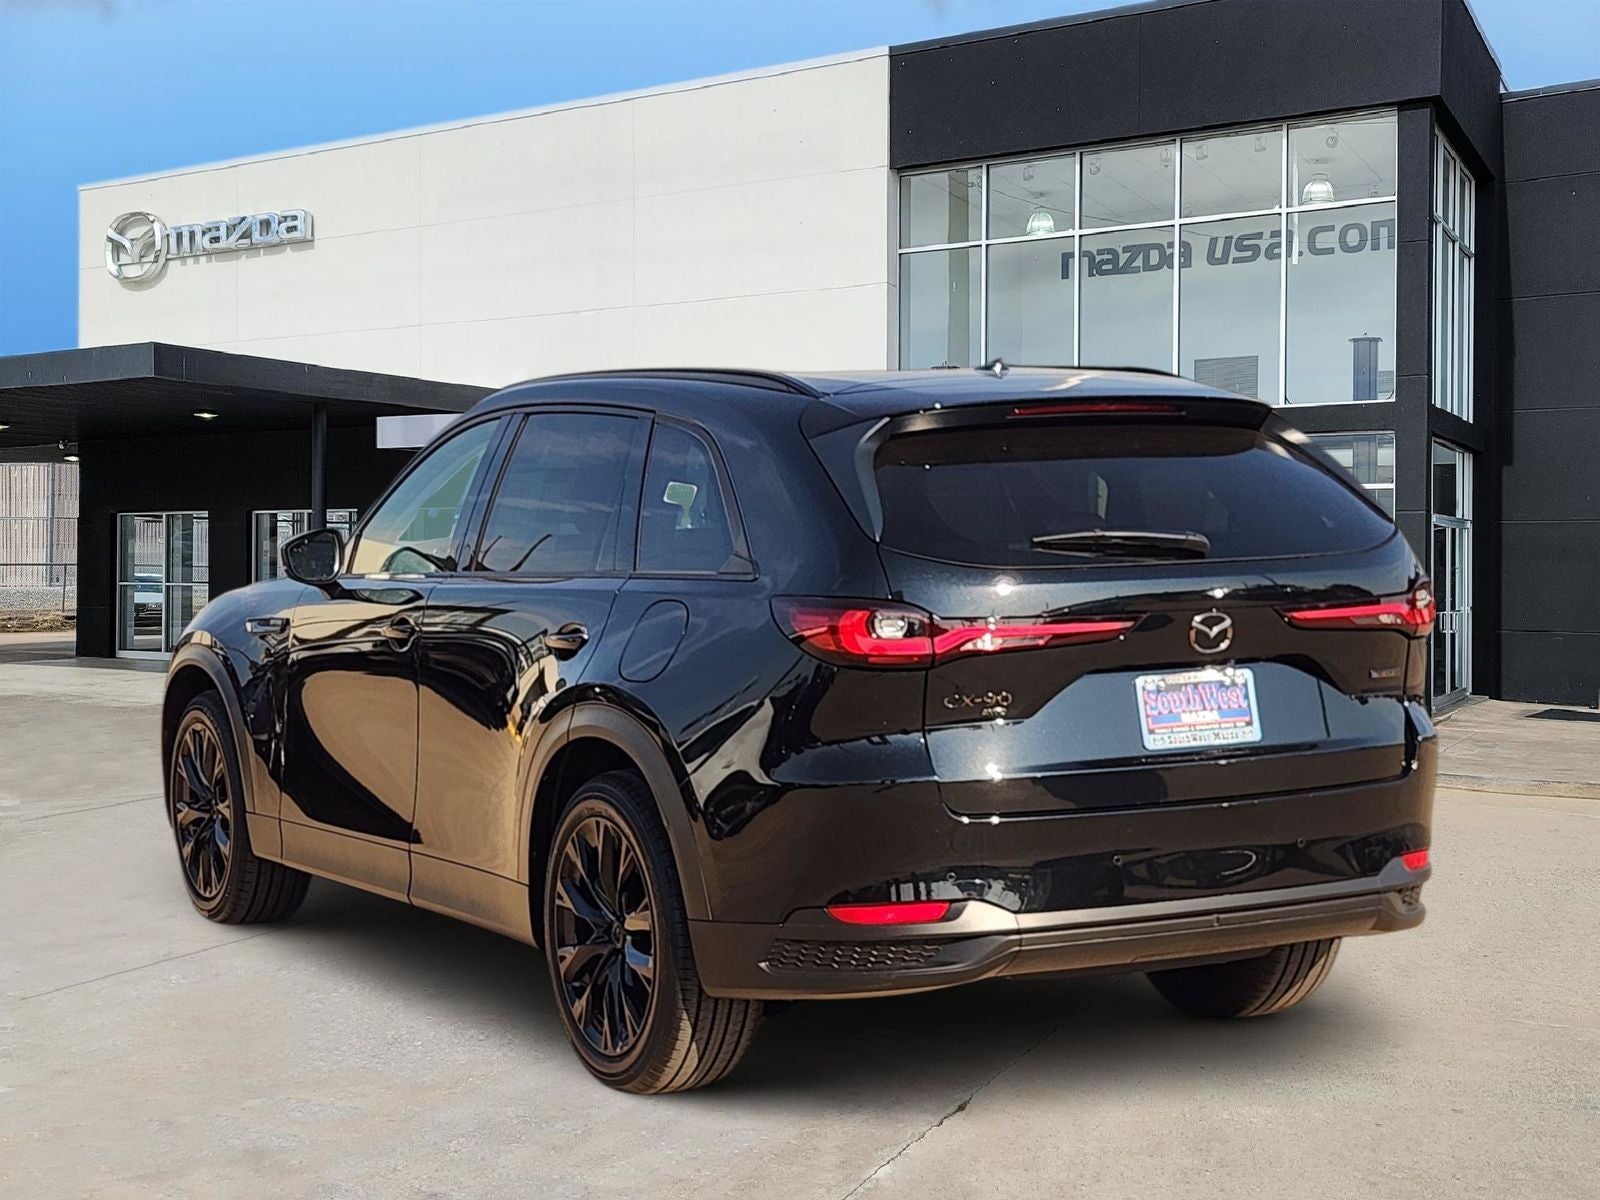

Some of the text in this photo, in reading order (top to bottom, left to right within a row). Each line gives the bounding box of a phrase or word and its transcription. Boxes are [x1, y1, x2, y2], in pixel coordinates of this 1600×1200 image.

[167, 208, 314, 257] mazda
[1061, 235, 1192, 280] mazda
[943, 690, 1013, 709] CX-90
